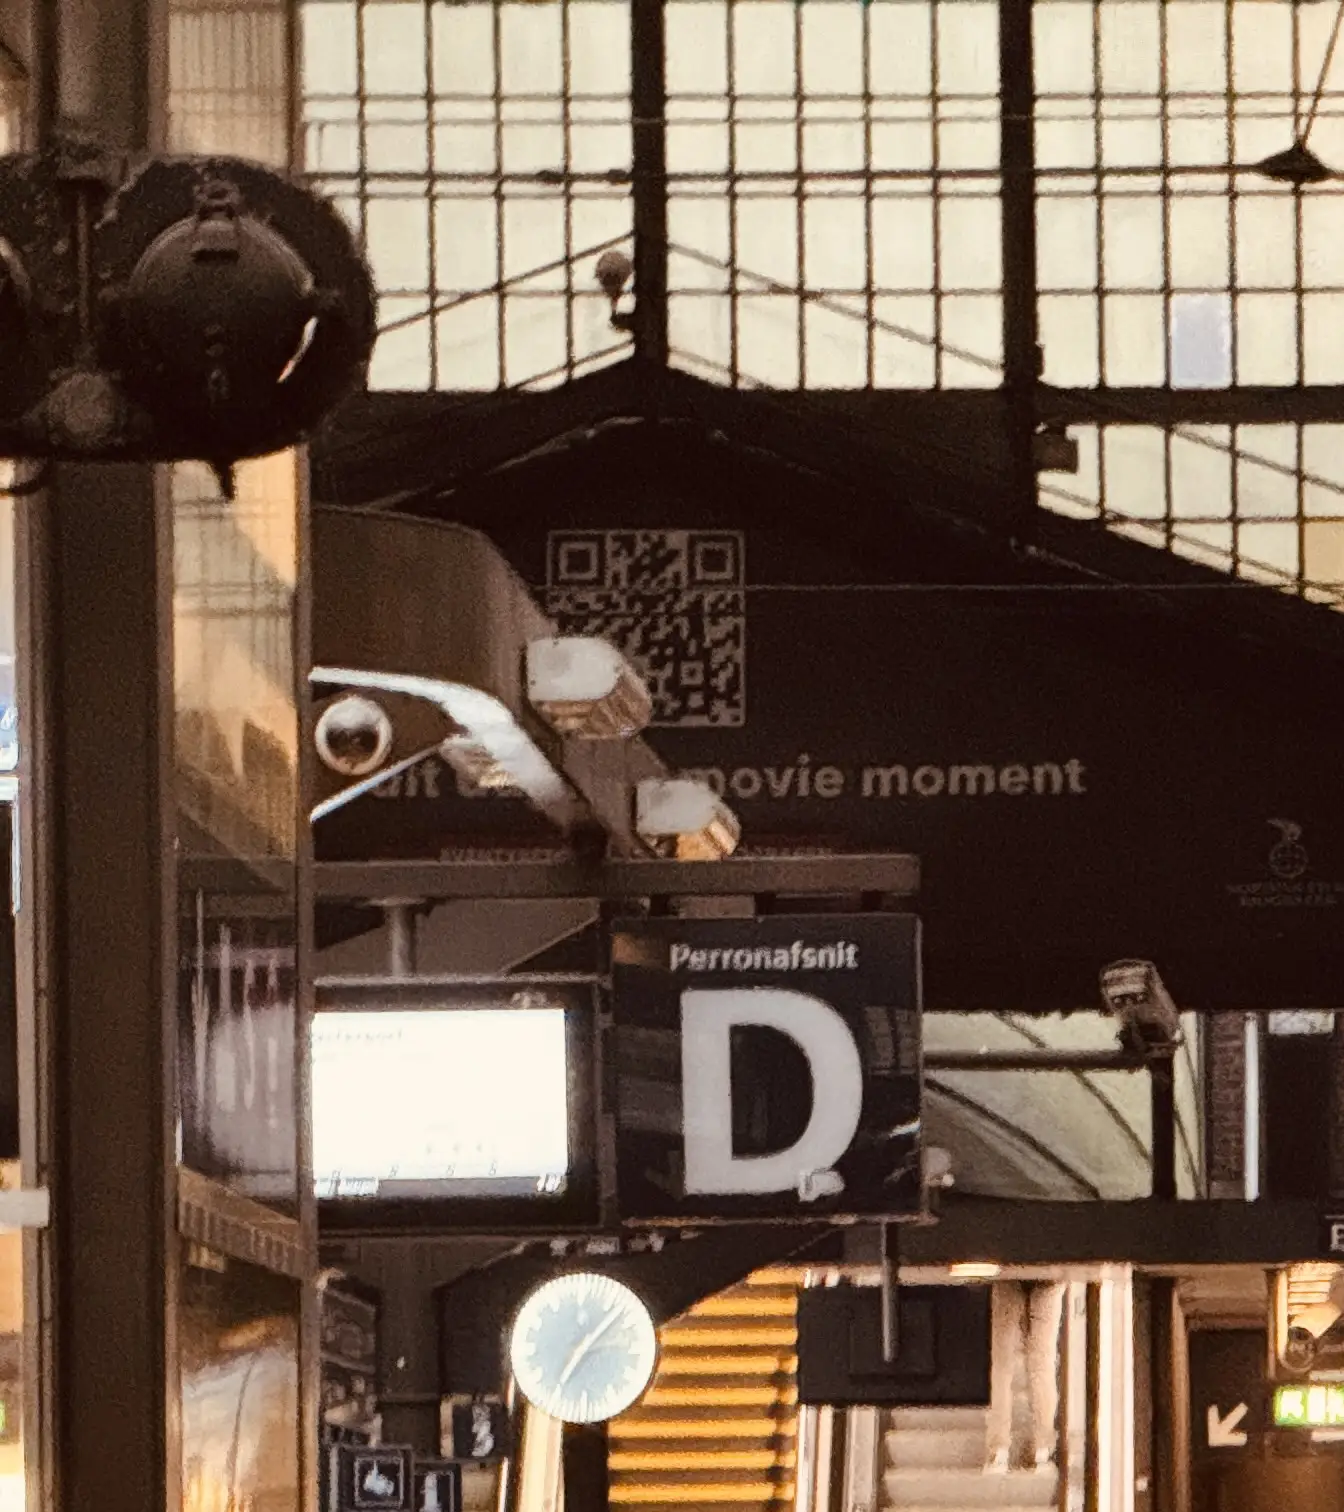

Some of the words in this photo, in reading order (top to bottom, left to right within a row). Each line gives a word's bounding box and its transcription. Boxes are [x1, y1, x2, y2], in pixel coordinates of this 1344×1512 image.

[861, 758, 1087, 797] moment
[668, 940, 860, 972] Perronafsnit
[680, 985, 864, 1196] D
